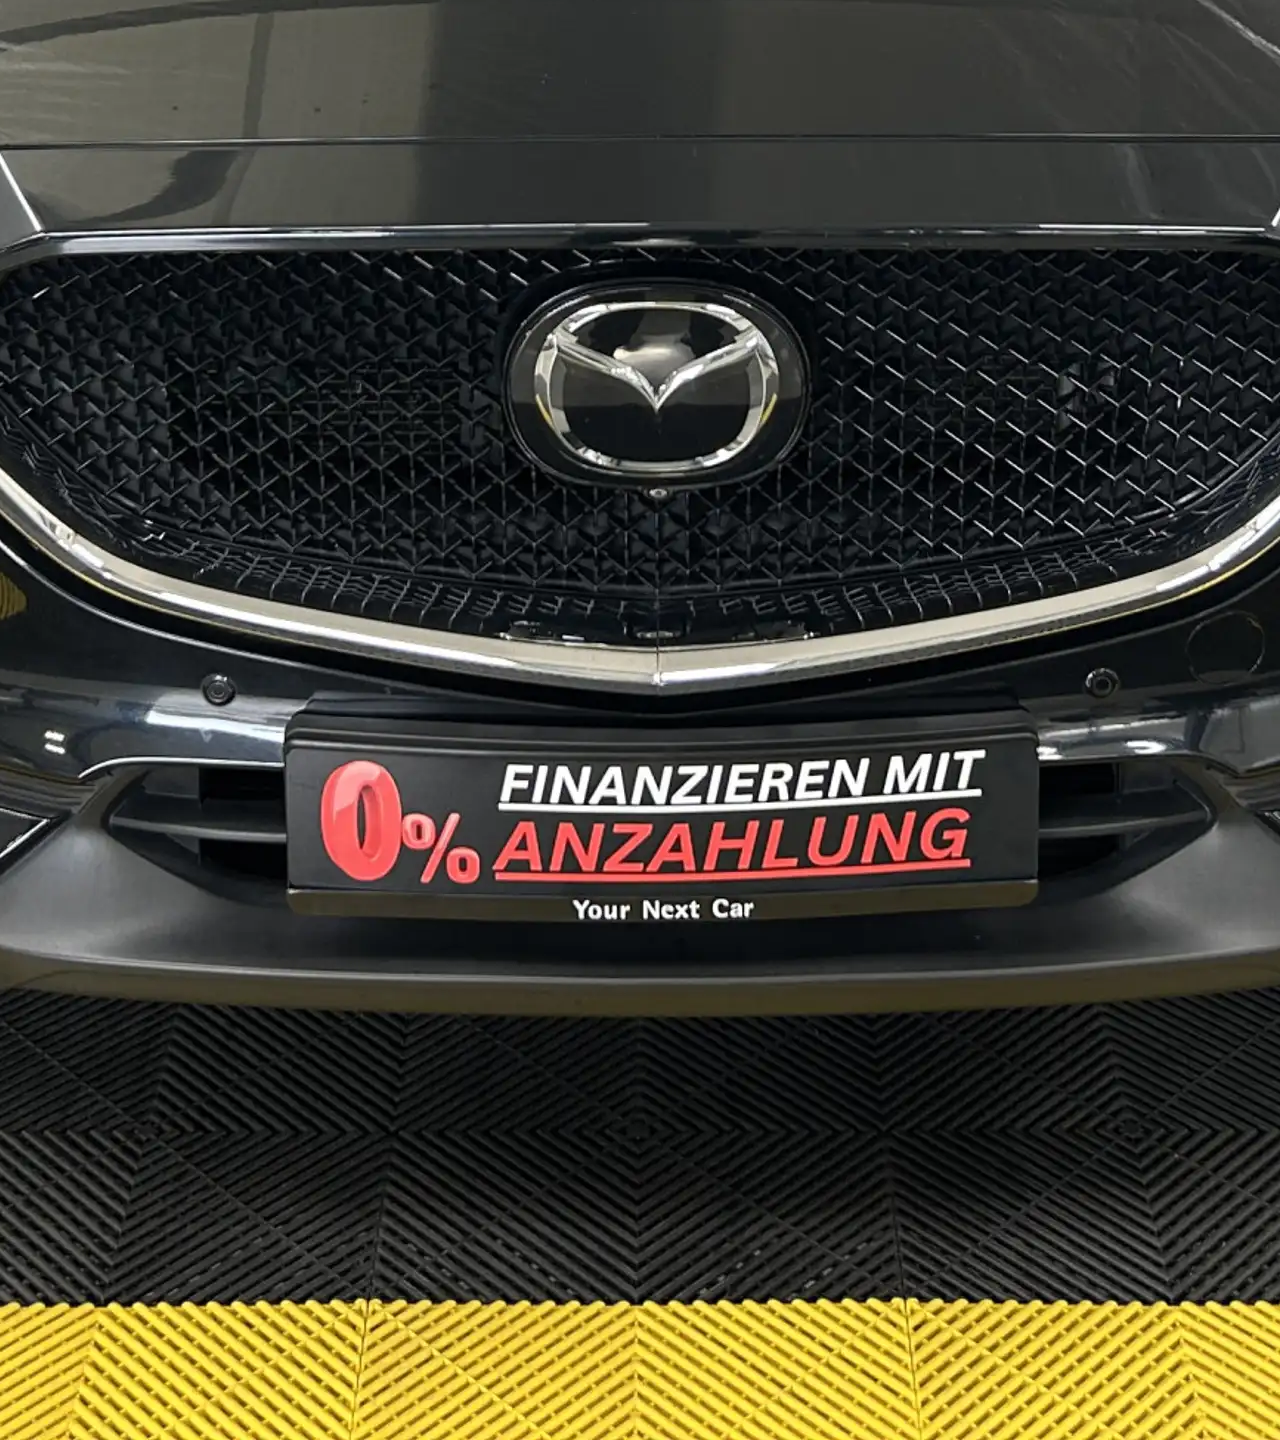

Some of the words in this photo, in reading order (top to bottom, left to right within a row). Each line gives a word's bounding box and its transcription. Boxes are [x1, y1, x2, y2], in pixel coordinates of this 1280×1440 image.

[500, 758, 870, 806] FINANZIEREN
[882, 750, 987, 795] MIT
[321, 759, 481, 884] 0%
[493, 808, 972, 873] ANZAHLUNG
[573, 899, 631, 920] Your
[641, 899, 700, 920] Next
[711, 898, 755, 919] Car
